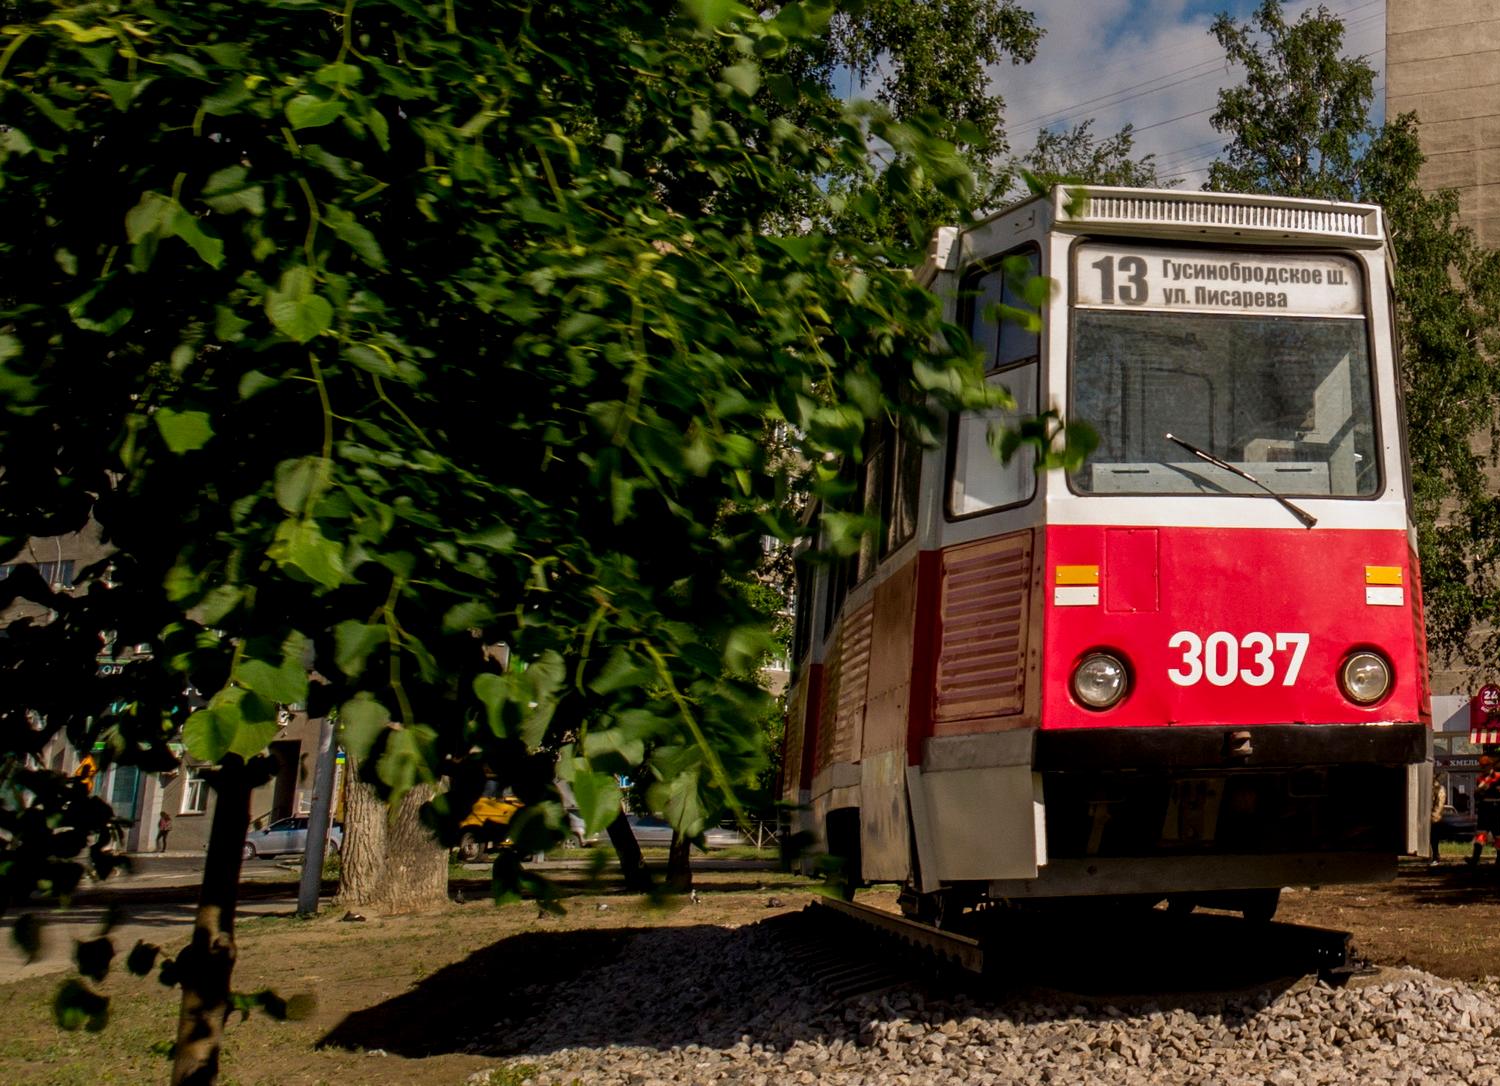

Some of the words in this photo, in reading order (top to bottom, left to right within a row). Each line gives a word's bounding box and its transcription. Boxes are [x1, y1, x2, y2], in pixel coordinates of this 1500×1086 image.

[1092, 255, 1148, 305] 13
[1163, 259, 1322, 286] Гусинобродское
[1327, 268, 1348, 285] ш.
[1163, 287, 1190, 305] ул.
[1195, 286, 1287, 308] Писарева
[1168, 630, 1310, 686] 3037
